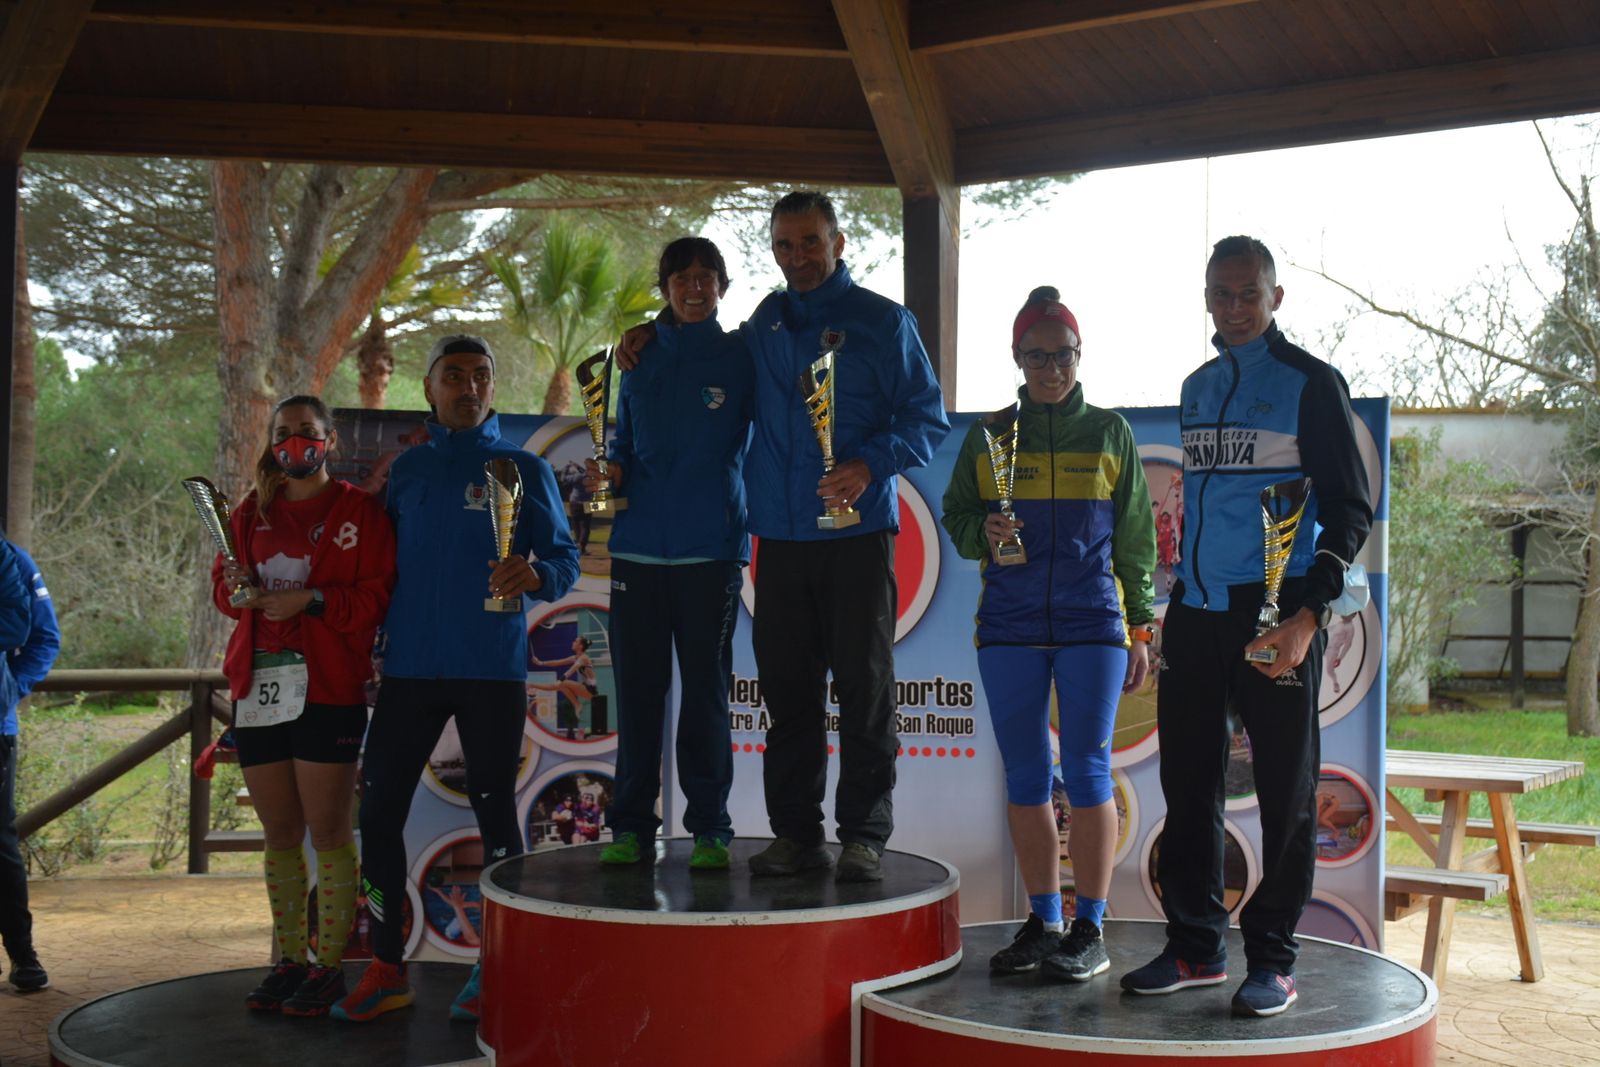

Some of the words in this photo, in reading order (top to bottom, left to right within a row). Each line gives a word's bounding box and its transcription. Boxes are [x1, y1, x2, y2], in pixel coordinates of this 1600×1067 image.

[258, 681, 281, 706] 52
[895, 677, 973, 711] portes
[926, 714, 974, 737] Roque
